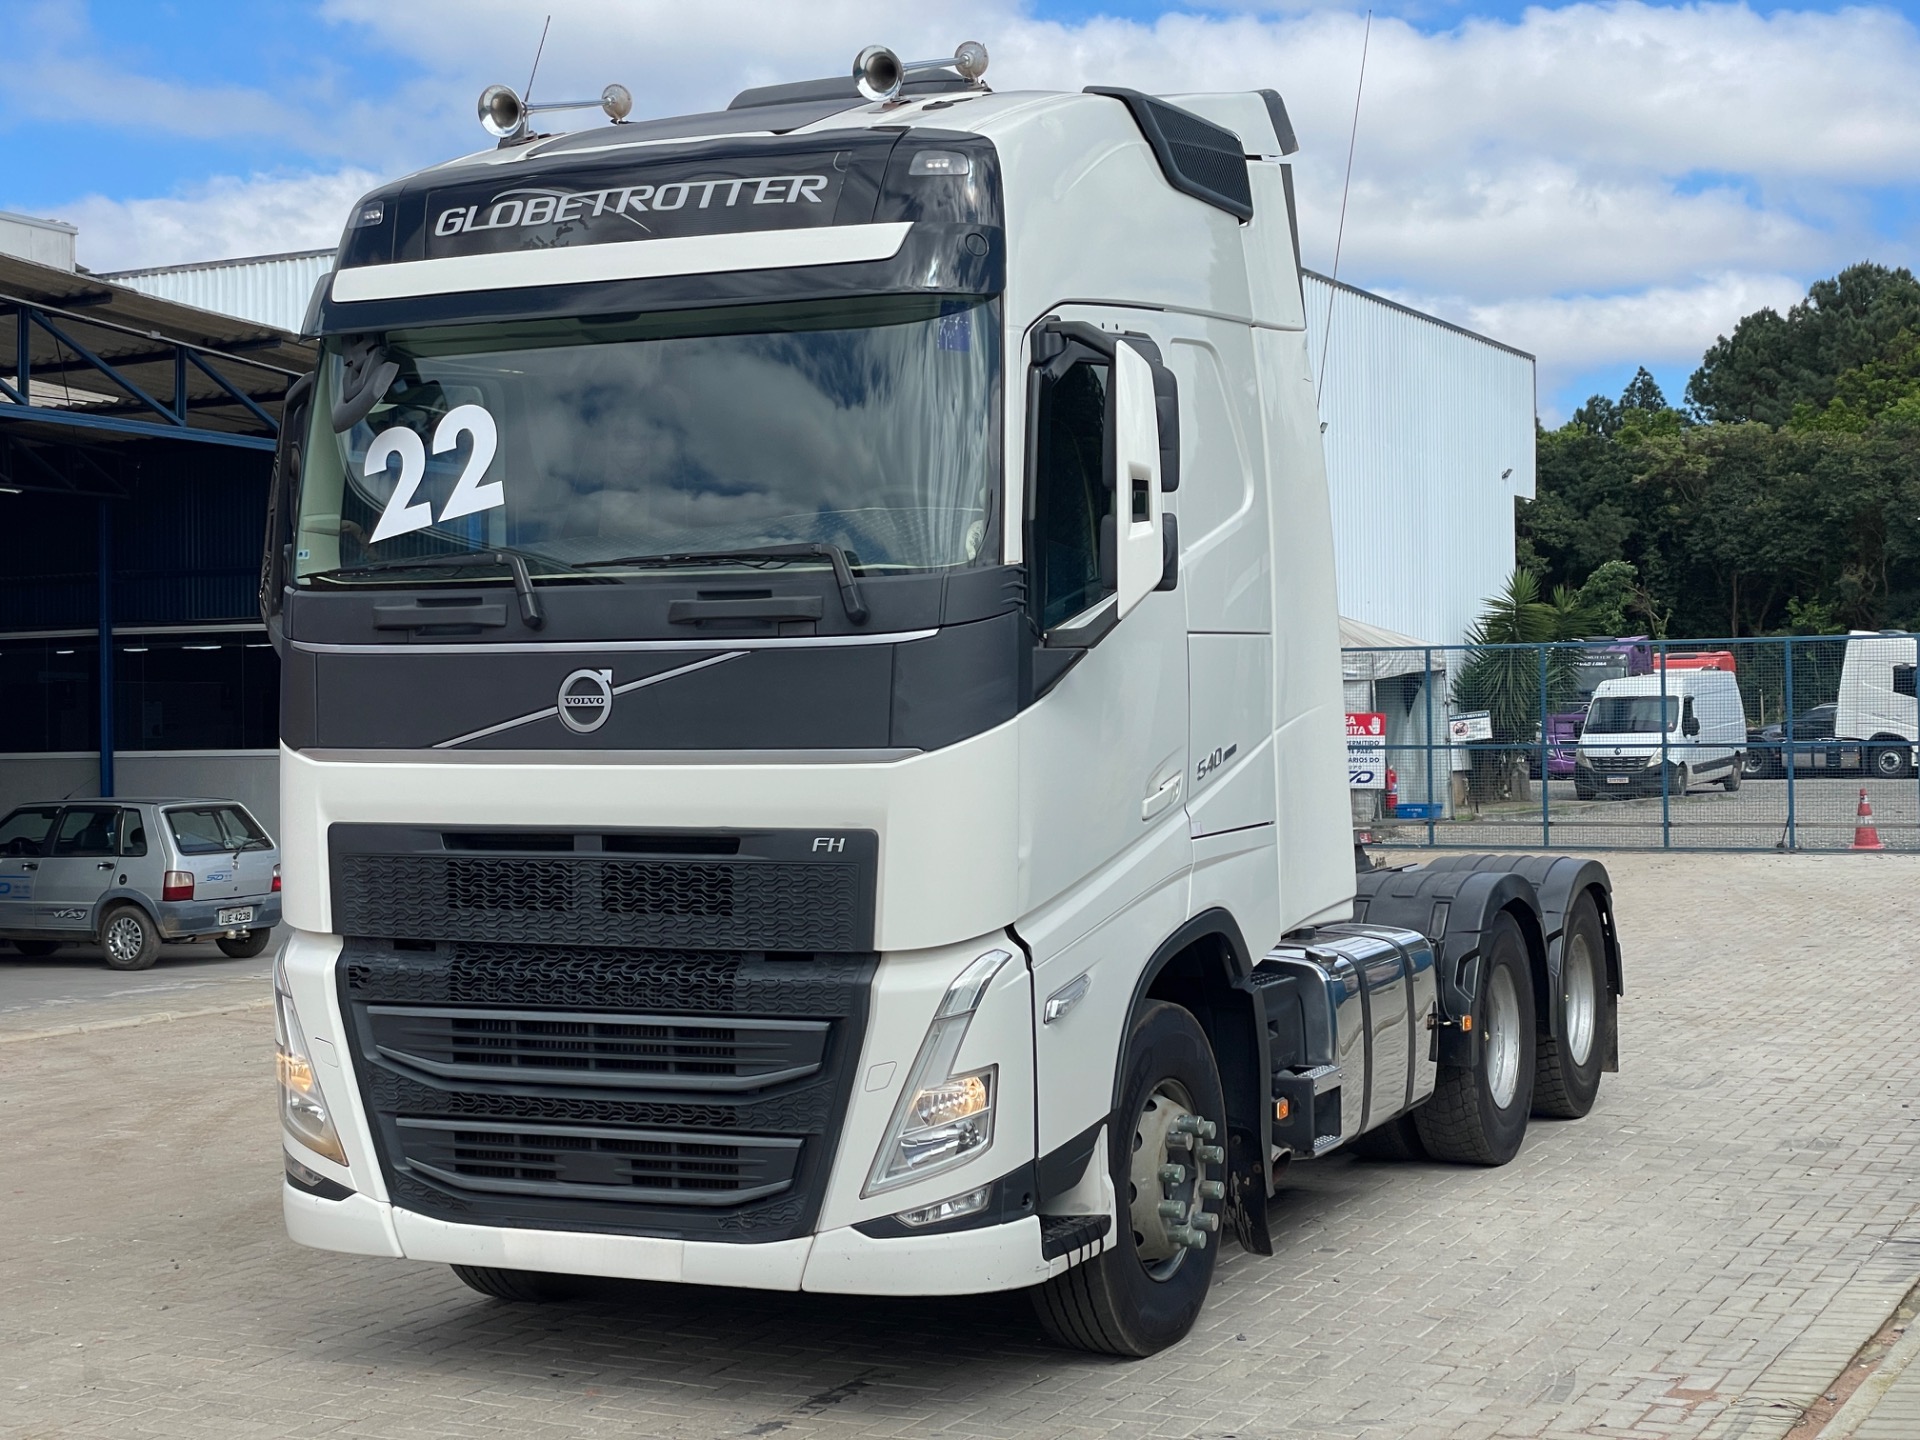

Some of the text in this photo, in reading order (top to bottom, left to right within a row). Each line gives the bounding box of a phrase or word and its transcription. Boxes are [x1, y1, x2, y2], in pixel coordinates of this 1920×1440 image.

[434, 175, 829, 237] GLOBETROTTER
[363, 404, 505, 544] 22
[564, 697, 604, 705] VOLVO
[1196, 747, 1222, 781] 540
[812, 837, 845, 852] FH
[52, 908, 86, 920] Way
